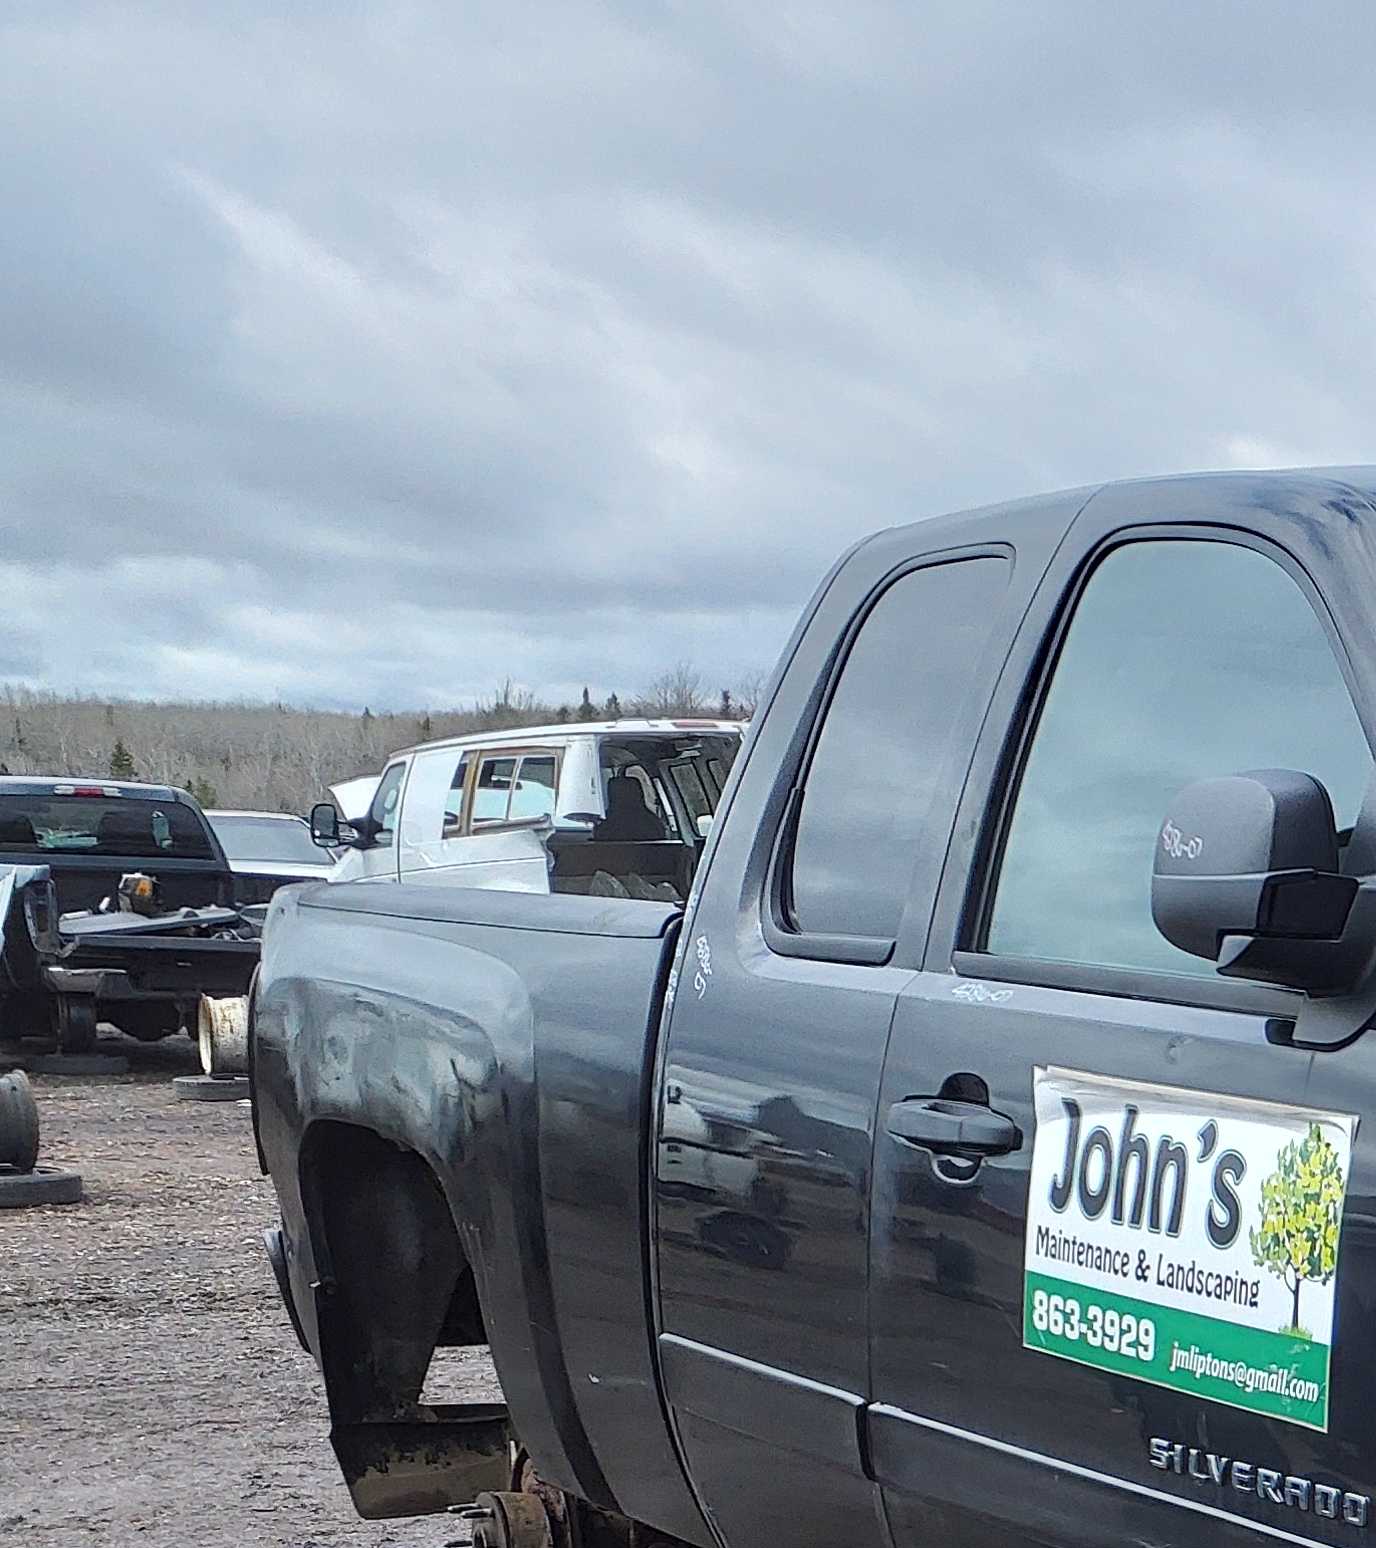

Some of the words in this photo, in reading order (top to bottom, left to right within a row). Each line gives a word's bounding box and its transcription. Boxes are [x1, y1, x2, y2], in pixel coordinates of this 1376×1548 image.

[1048, 1096, 1247, 1250] John's
[1036, 1224, 1130, 1280] Maintenance
[1134, 1247, 1152, 1282] &
[1157, 1254, 1260, 1308] Landscaping
[1032, 1289, 1156, 1361] 863-3929
[1169, 1341, 1319, 1403] jmliptons@gmail.com
[1150, 1437, 1370, 1528] SILVERADO
